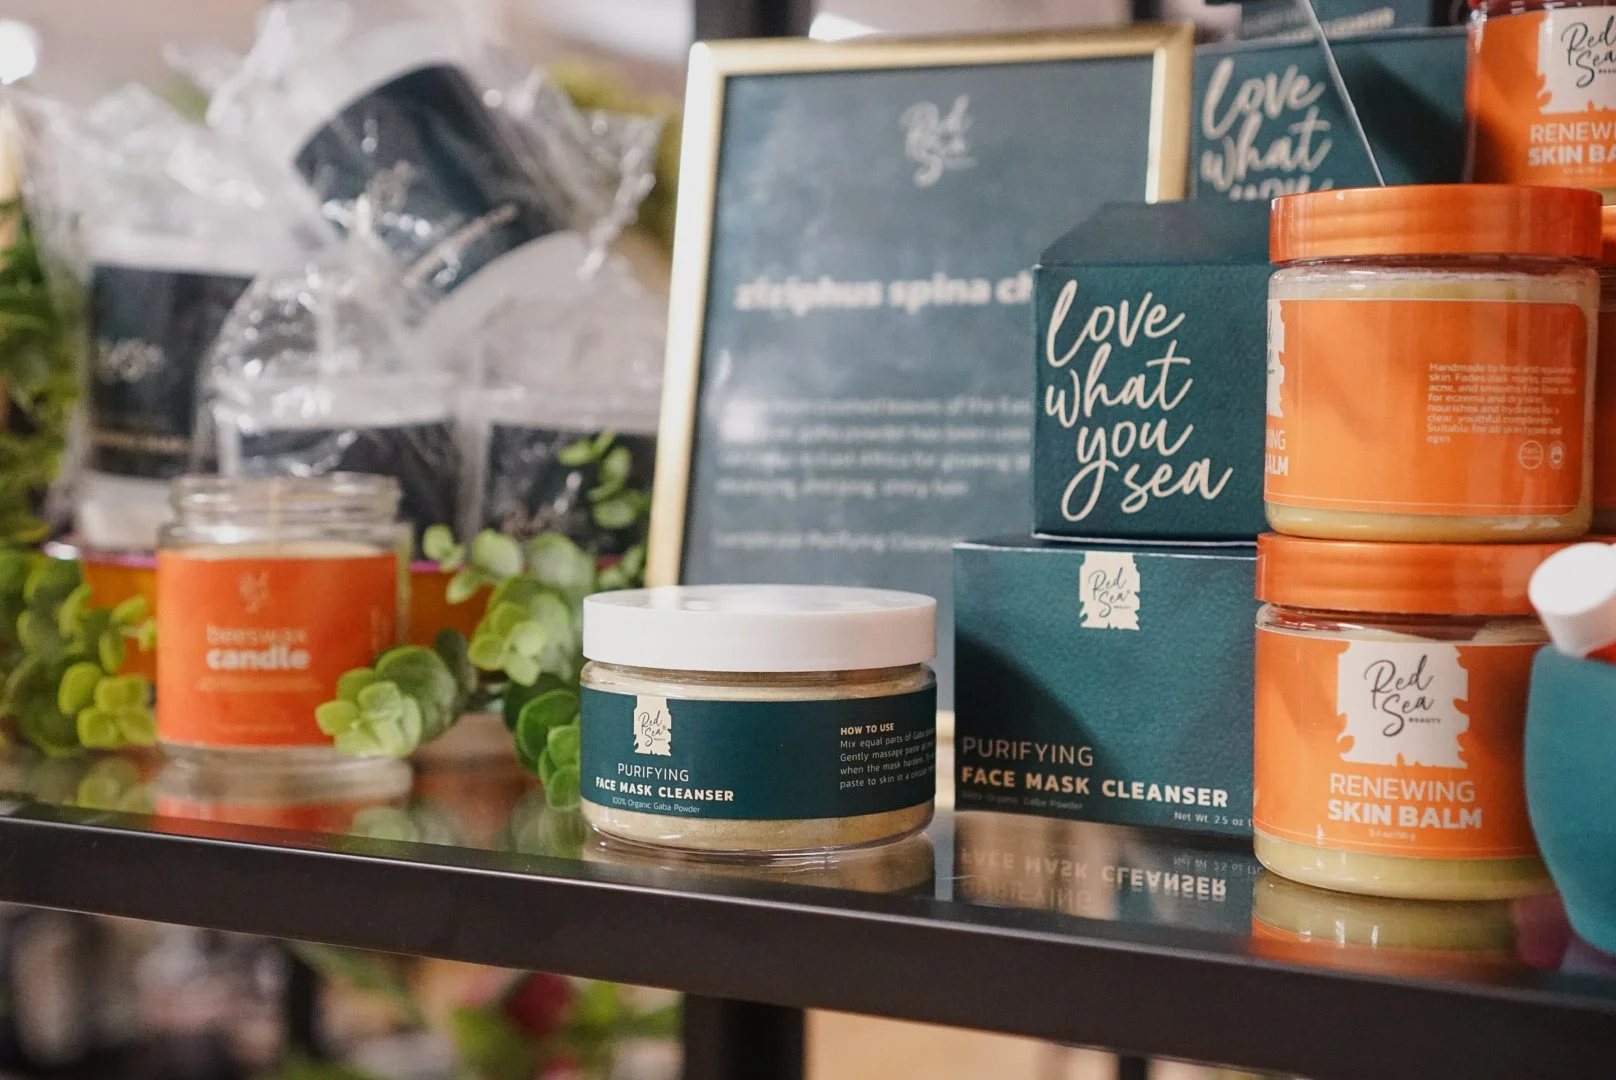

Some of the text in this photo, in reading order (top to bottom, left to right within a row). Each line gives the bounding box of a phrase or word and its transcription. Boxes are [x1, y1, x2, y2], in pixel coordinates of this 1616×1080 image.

[1528, 144, 1583, 167] SKIN
[1429, 363, 1487, 373] Handmade
[1488, 364, 1498, 373] to
[1046, 339, 1194, 429] what
[1458, 384, 1478, 393] and
[1428, 393, 1442, 402] for
[1480, 405, 1499, 414] and
[1471, 424, 1486, 434] for
[1061, 418, 1194, 522] you
[1120, 457, 1234, 514] sea
[1088, 567, 1128, 601] Red
[1099, 591, 1129, 618] Sea
[206, 643, 311, 670] candle
[1363, 654, 1434, 710] Red
[638, 710, 663, 735] Red
[1381, 694, 1434, 737] Sea
[1408, 716, 1442, 725] BEAUTY
[644, 727, 664, 747] Sea
[840, 723, 895, 736] HOW TO USE
[840, 741, 856, 749] Mix
[860, 737, 883, 749] equal
[885, 735, 903, 747] parts
[962, 736, 1094, 767] PURIFYING
[840, 752, 869, 763] Gently
[872, 748, 903, 759] massage
[617, 762, 690, 782] PURIFYING
[840, 765, 864, 775] when
[867, 764, 881, 773] the
[883, 761, 901, 771] mask
[595, 776, 734, 802] FACE MASK CLEANSER
[840, 779, 864, 791] paste
[867, 778, 877, 786] to
[879, 775, 895, 785] skin
[962, 766, 1228, 808] FACE MASK CLEANSER
[1329, 772, 1476, 803] RENEWING
[612, 796, 701, 814] 100% Organic Gaba Powder
[1327, 798, 1483, 829] SKIN BALM
[1174, 811, 1191, 822] Net
[1195, 813, 1208, 823] Wt
[1231, 818, 1244, 827] oz
